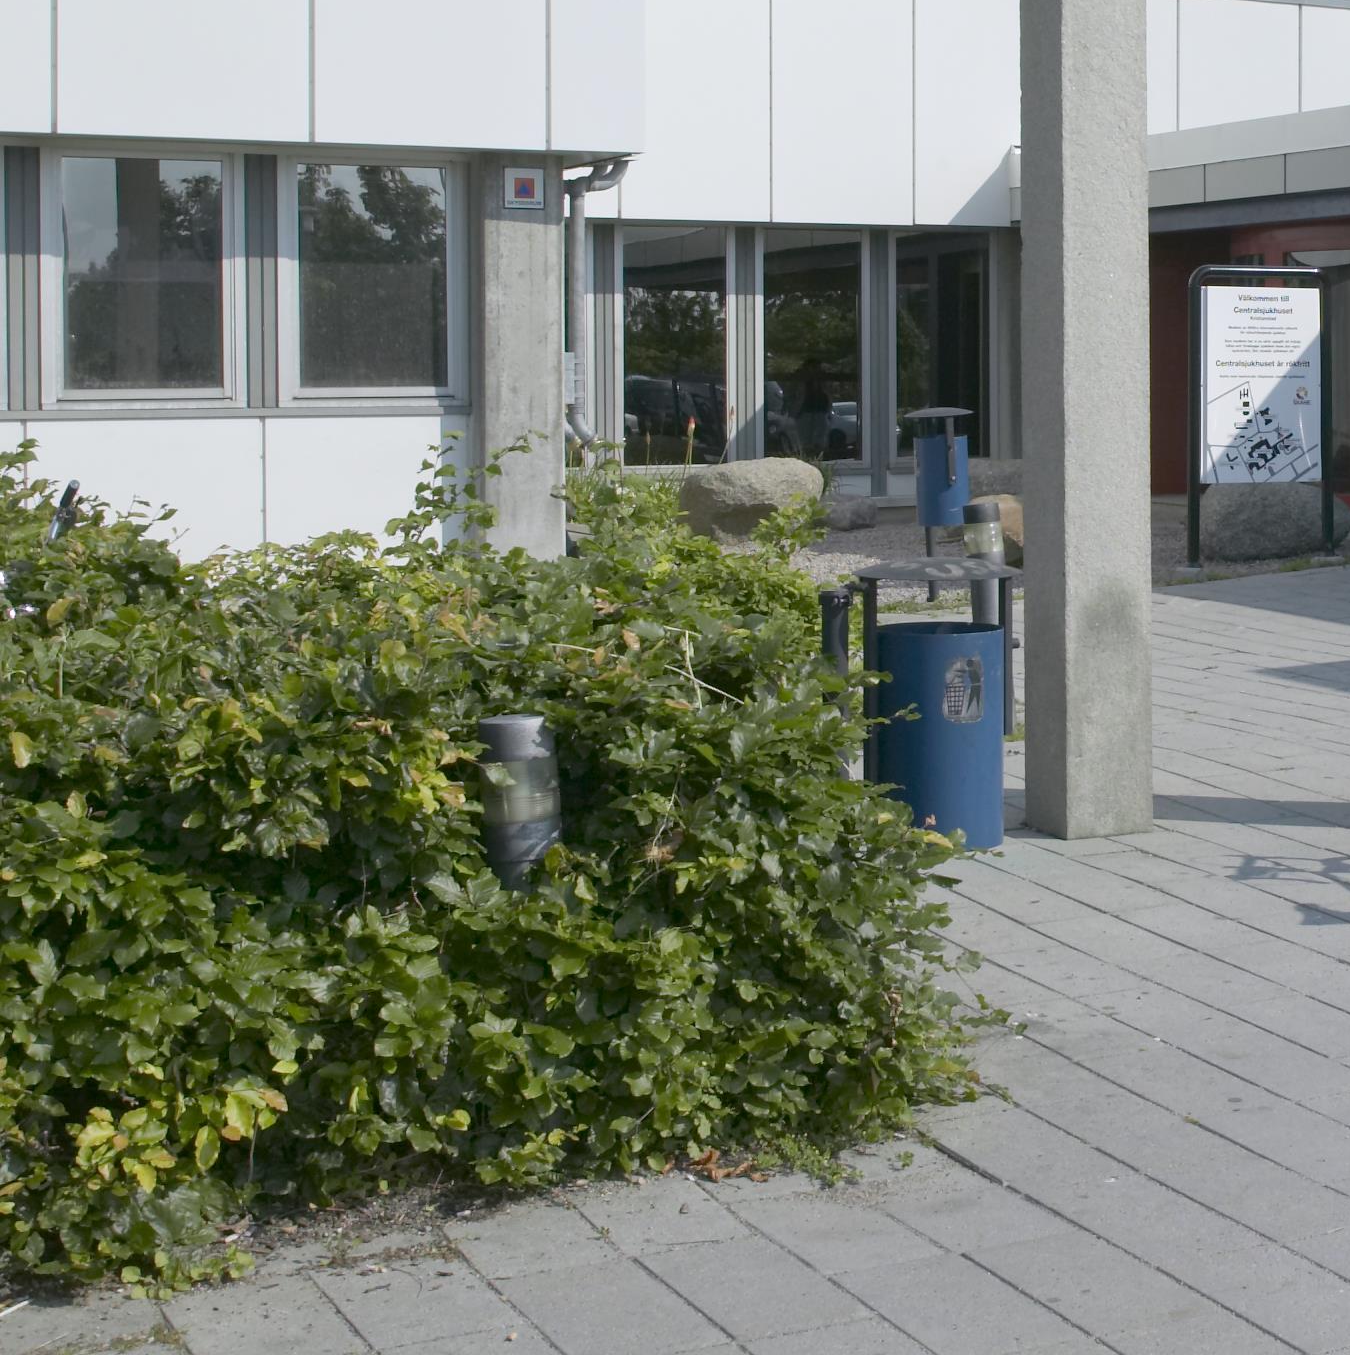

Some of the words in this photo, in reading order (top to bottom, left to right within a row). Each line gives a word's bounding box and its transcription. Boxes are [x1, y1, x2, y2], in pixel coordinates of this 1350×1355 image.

[1237, 294, 1279, 302] Välkommen
[1233, 306, 1293, 315] Centralsjukhuset
[1215, 359, 1275, 368] Centralsjukhuset
